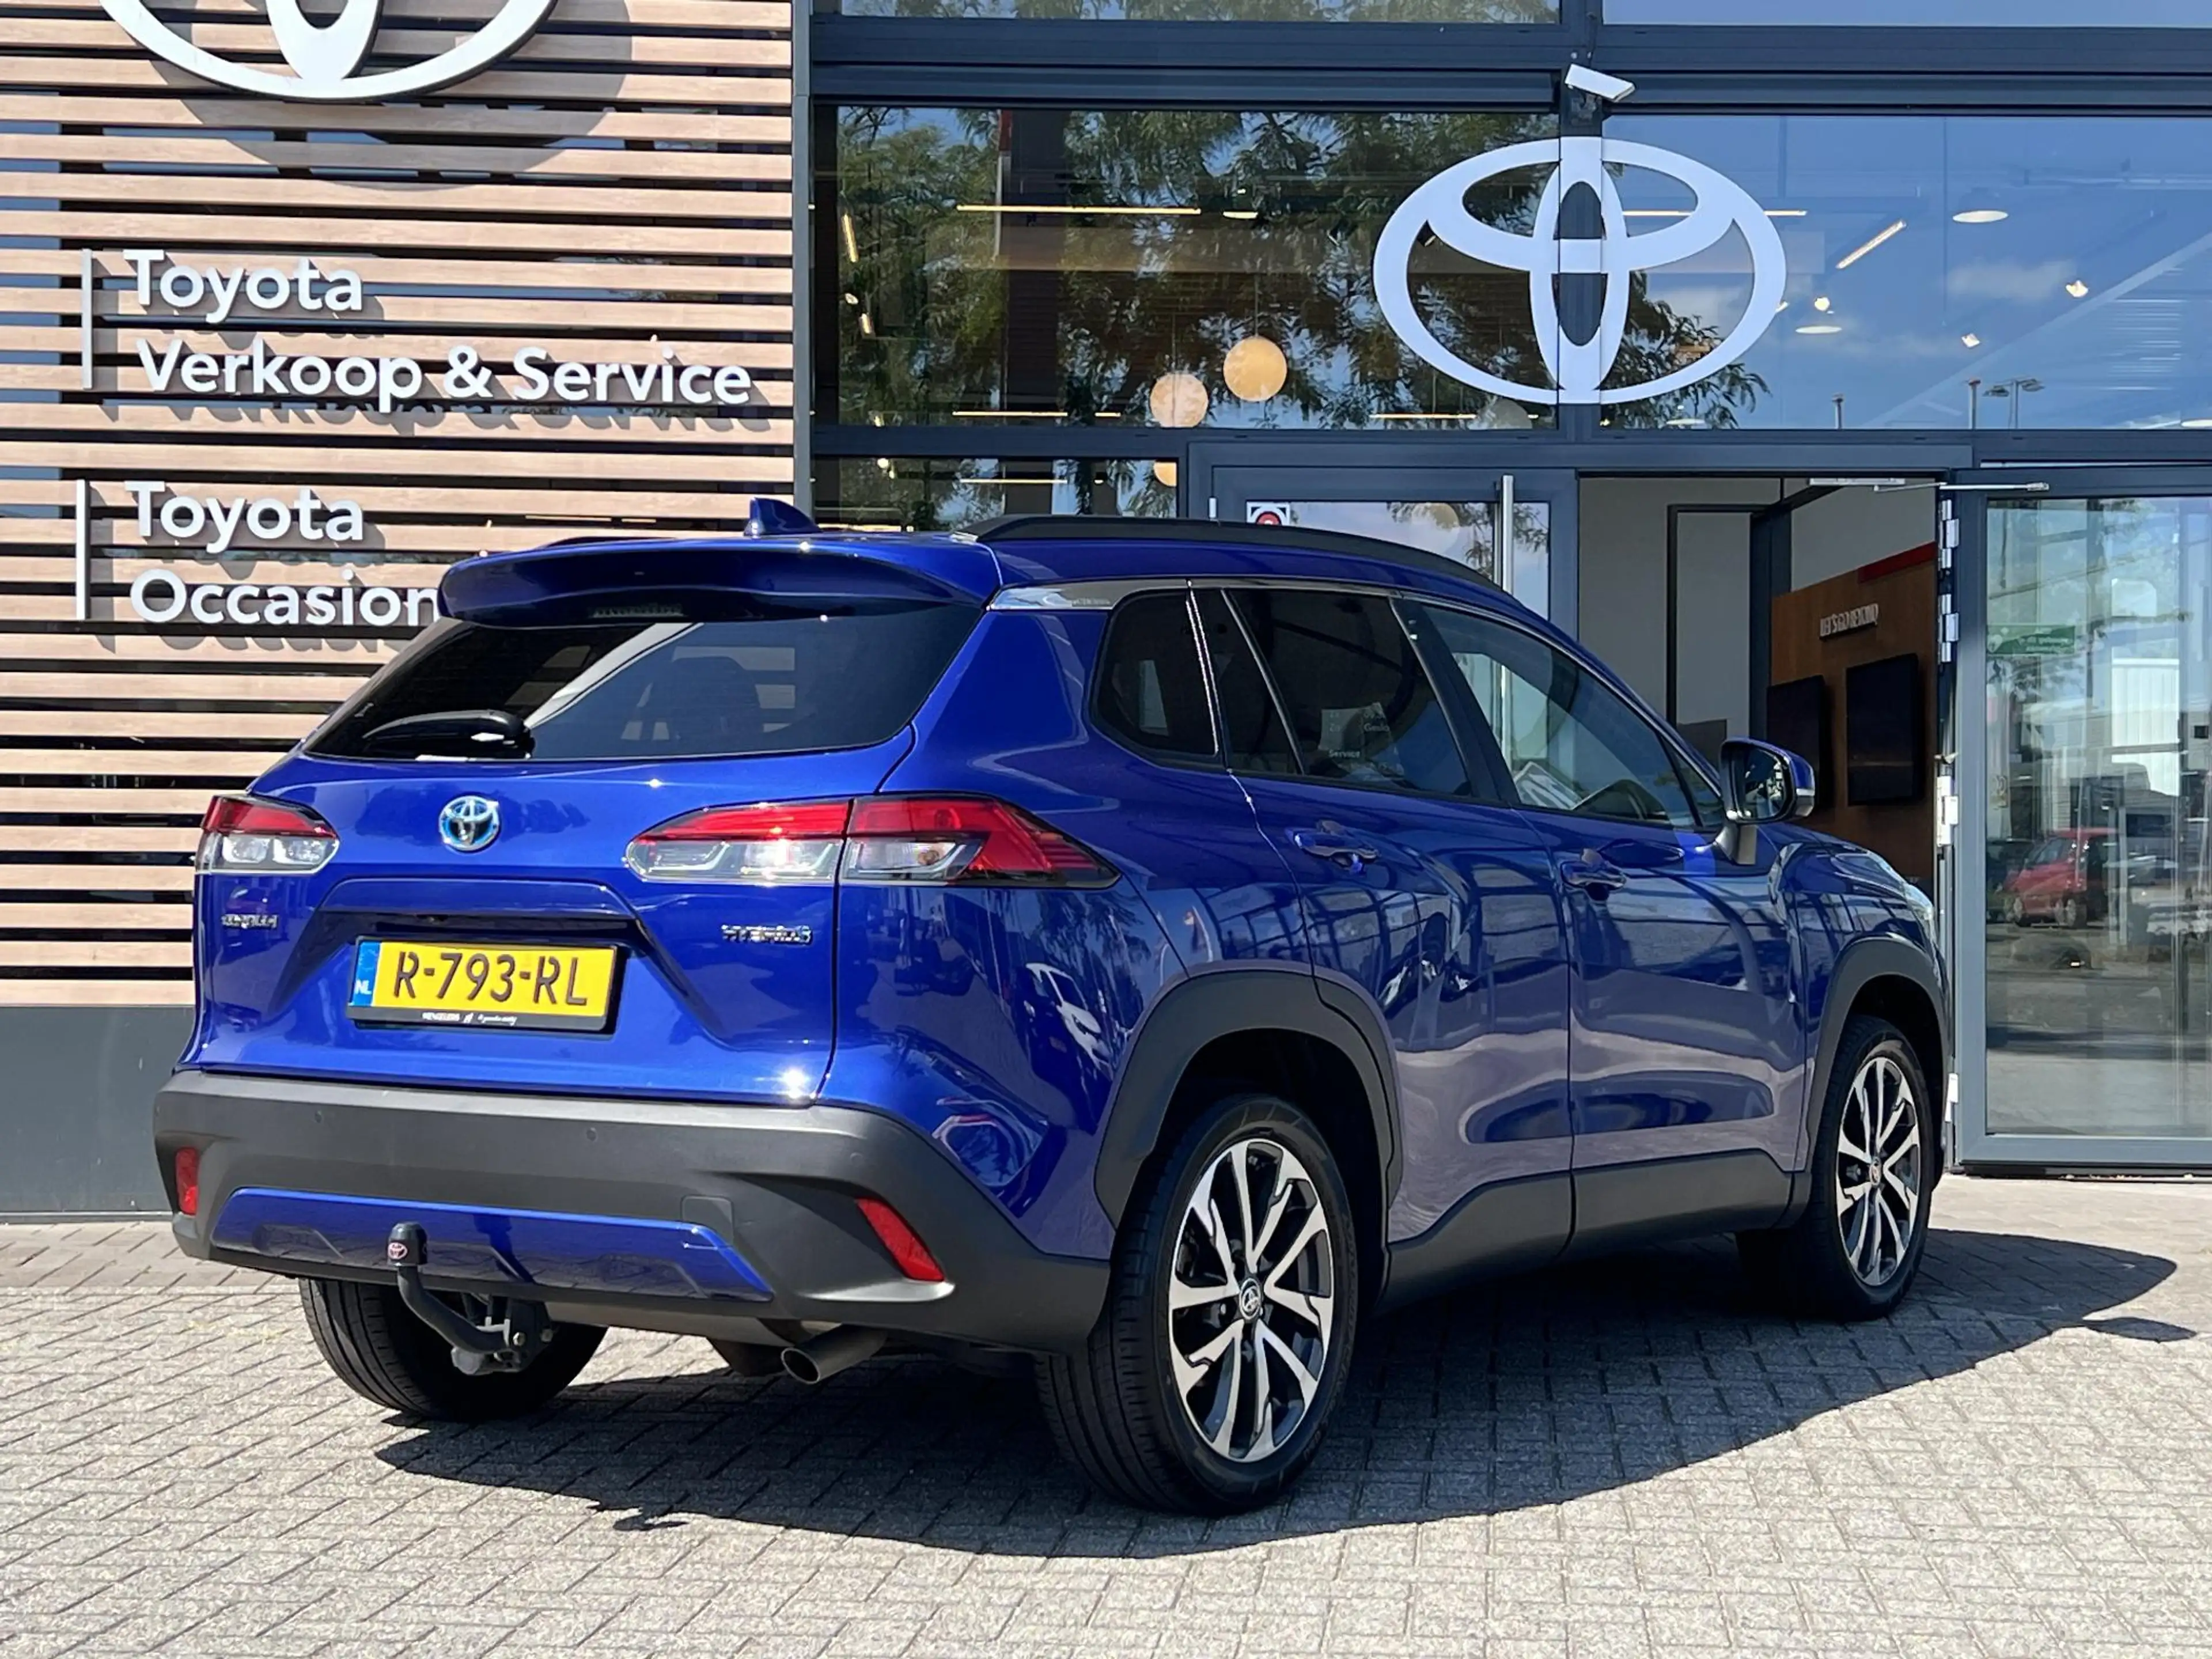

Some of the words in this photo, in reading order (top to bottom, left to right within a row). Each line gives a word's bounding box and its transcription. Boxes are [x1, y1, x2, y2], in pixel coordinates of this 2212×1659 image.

[123, 249, 363, 324] Toyota
[136, 338, 422, 413] Verkoop
[443, 344, 494, 400] &
[513, 345, 752, 404] Service
[124, 480, 363, 554] Toyota
[130, 568, 438, 627] Occasion
[354, 979, 372, 995] NL
[393, 950, 588, 1006] R-793-RL
